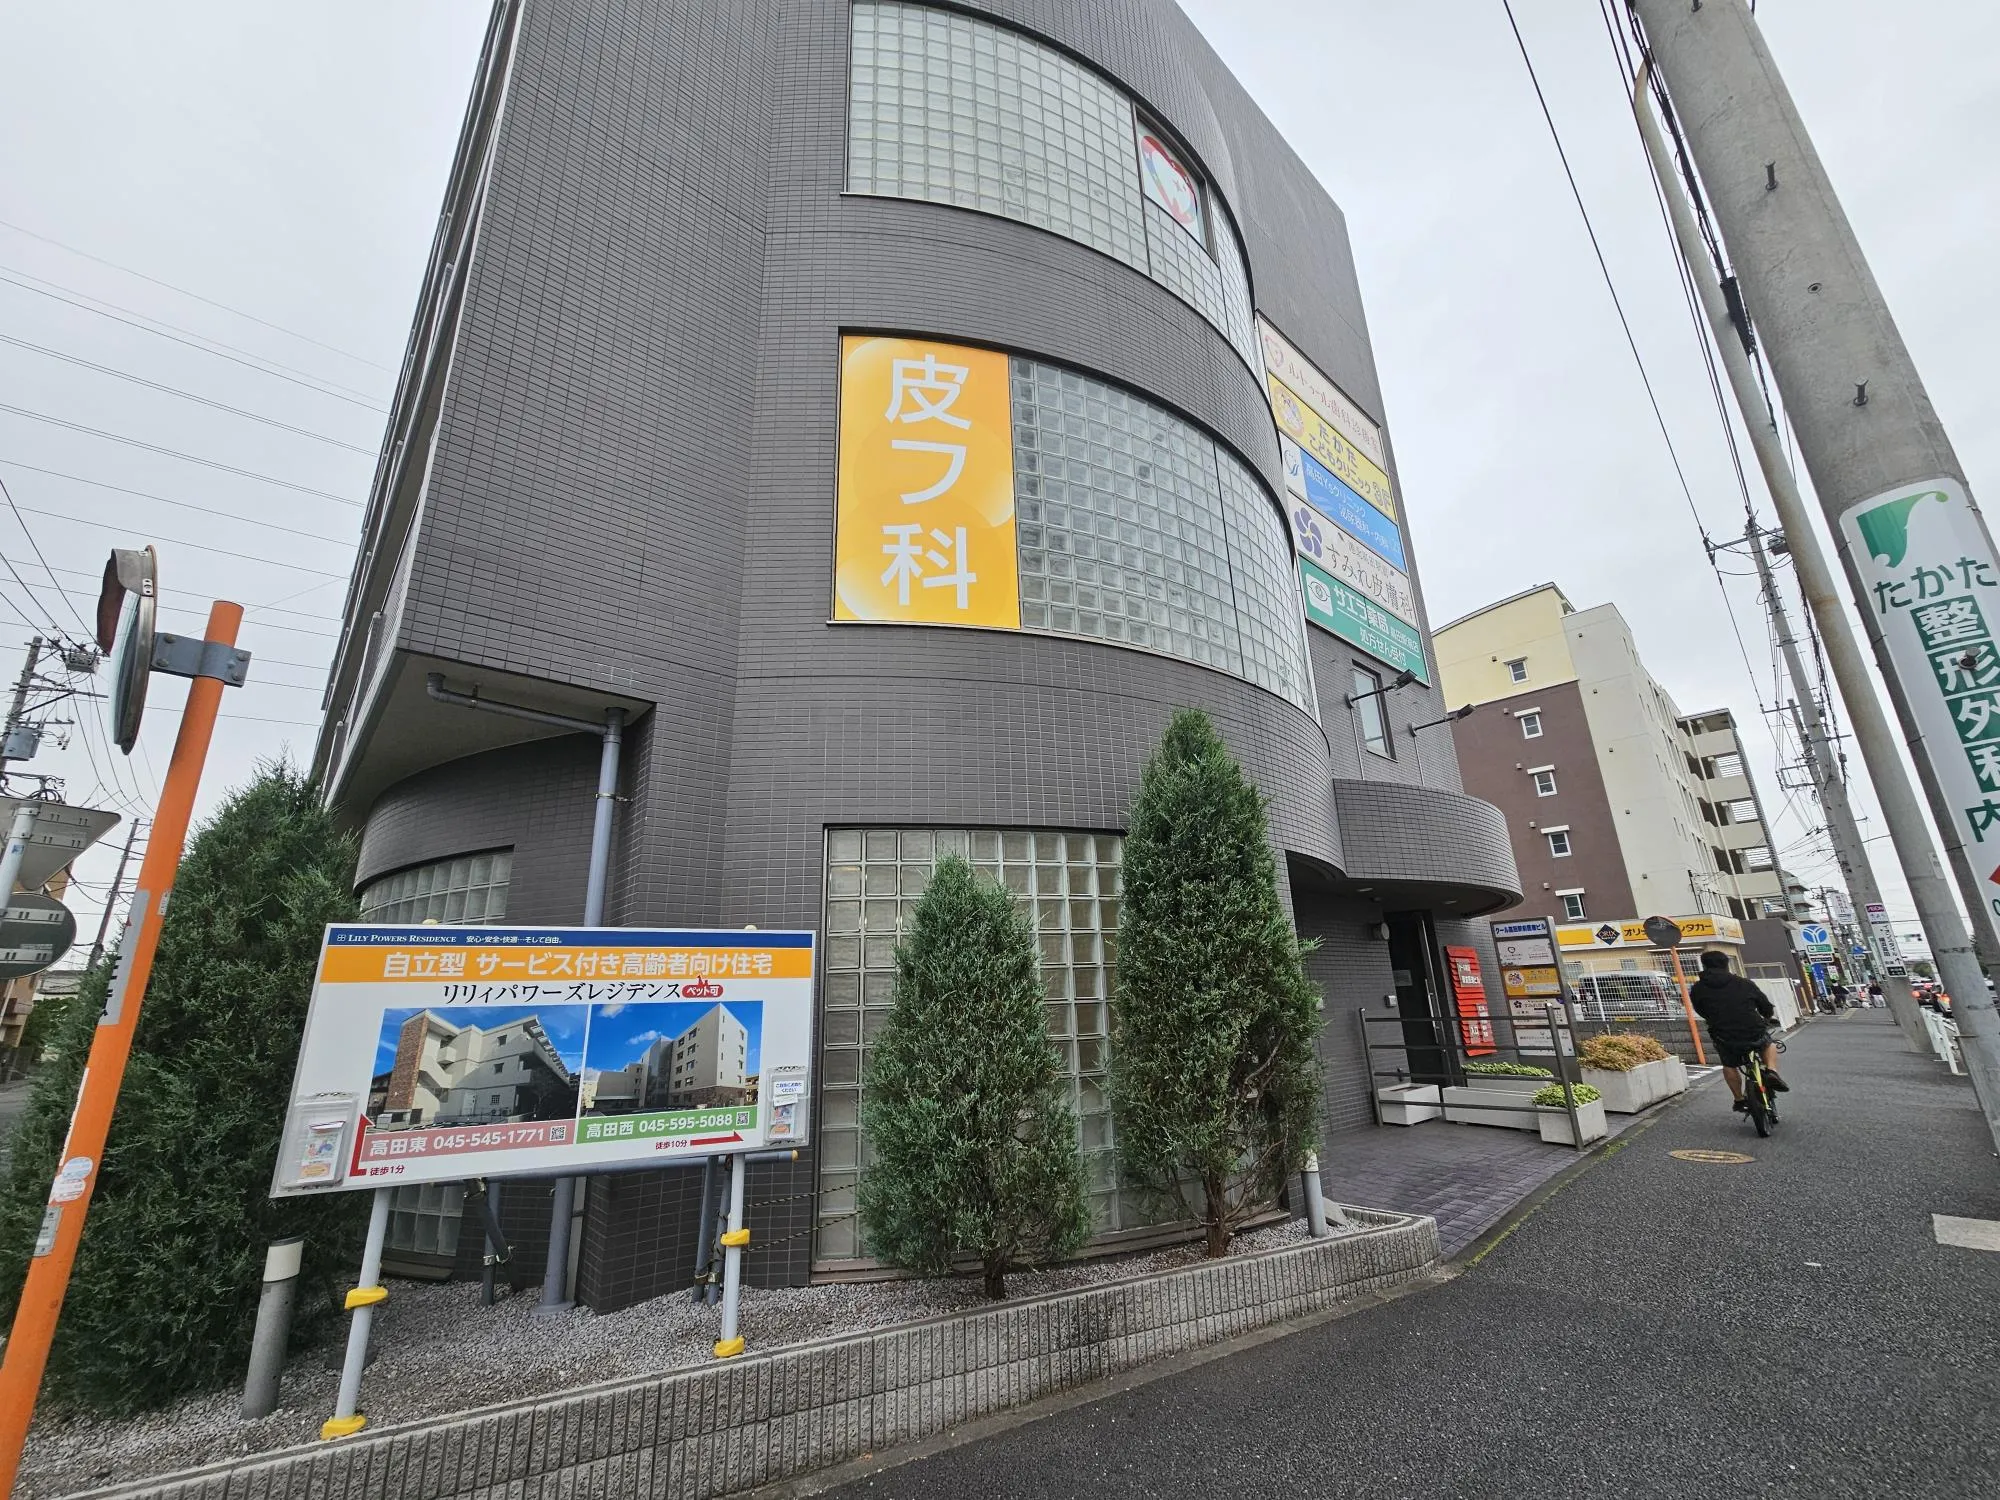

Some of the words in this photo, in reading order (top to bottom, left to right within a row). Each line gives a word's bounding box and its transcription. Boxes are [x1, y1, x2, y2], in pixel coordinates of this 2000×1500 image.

[1318, 421, 1358, 469] たかた
[1308, 432, 1371, 494] こどもクリニック
[879, 353, 977, 609] 皮フ科
[1325, 543, 1414, 621] すみれ皮膚科
[1873, 556, 1998, 614] たかた
[1333, 584, 1390, 635] サエラ薬局
[1359, 627, 1407, 667] 処方せん受付
[383, 952, 467, 977] 自立型
[476, 952, 772, 976] サービス付き高齢者向け住宅
[443, 982, 681, 1005] リリィパワーズレジデンス
[686, 985, 720, 997] ペット可
[369, 1136, 427, 1157] 高田東
[433, 1128, 544, 1150] 045-545-1771
[586, 1120, 635, 1139] 高田西
[638, 1113, 733, 1133] 045-595-5088
[655, 1139, 688, 1150] 徒歩10分
[370, 1165, 405, 1176] 徒歩1分
